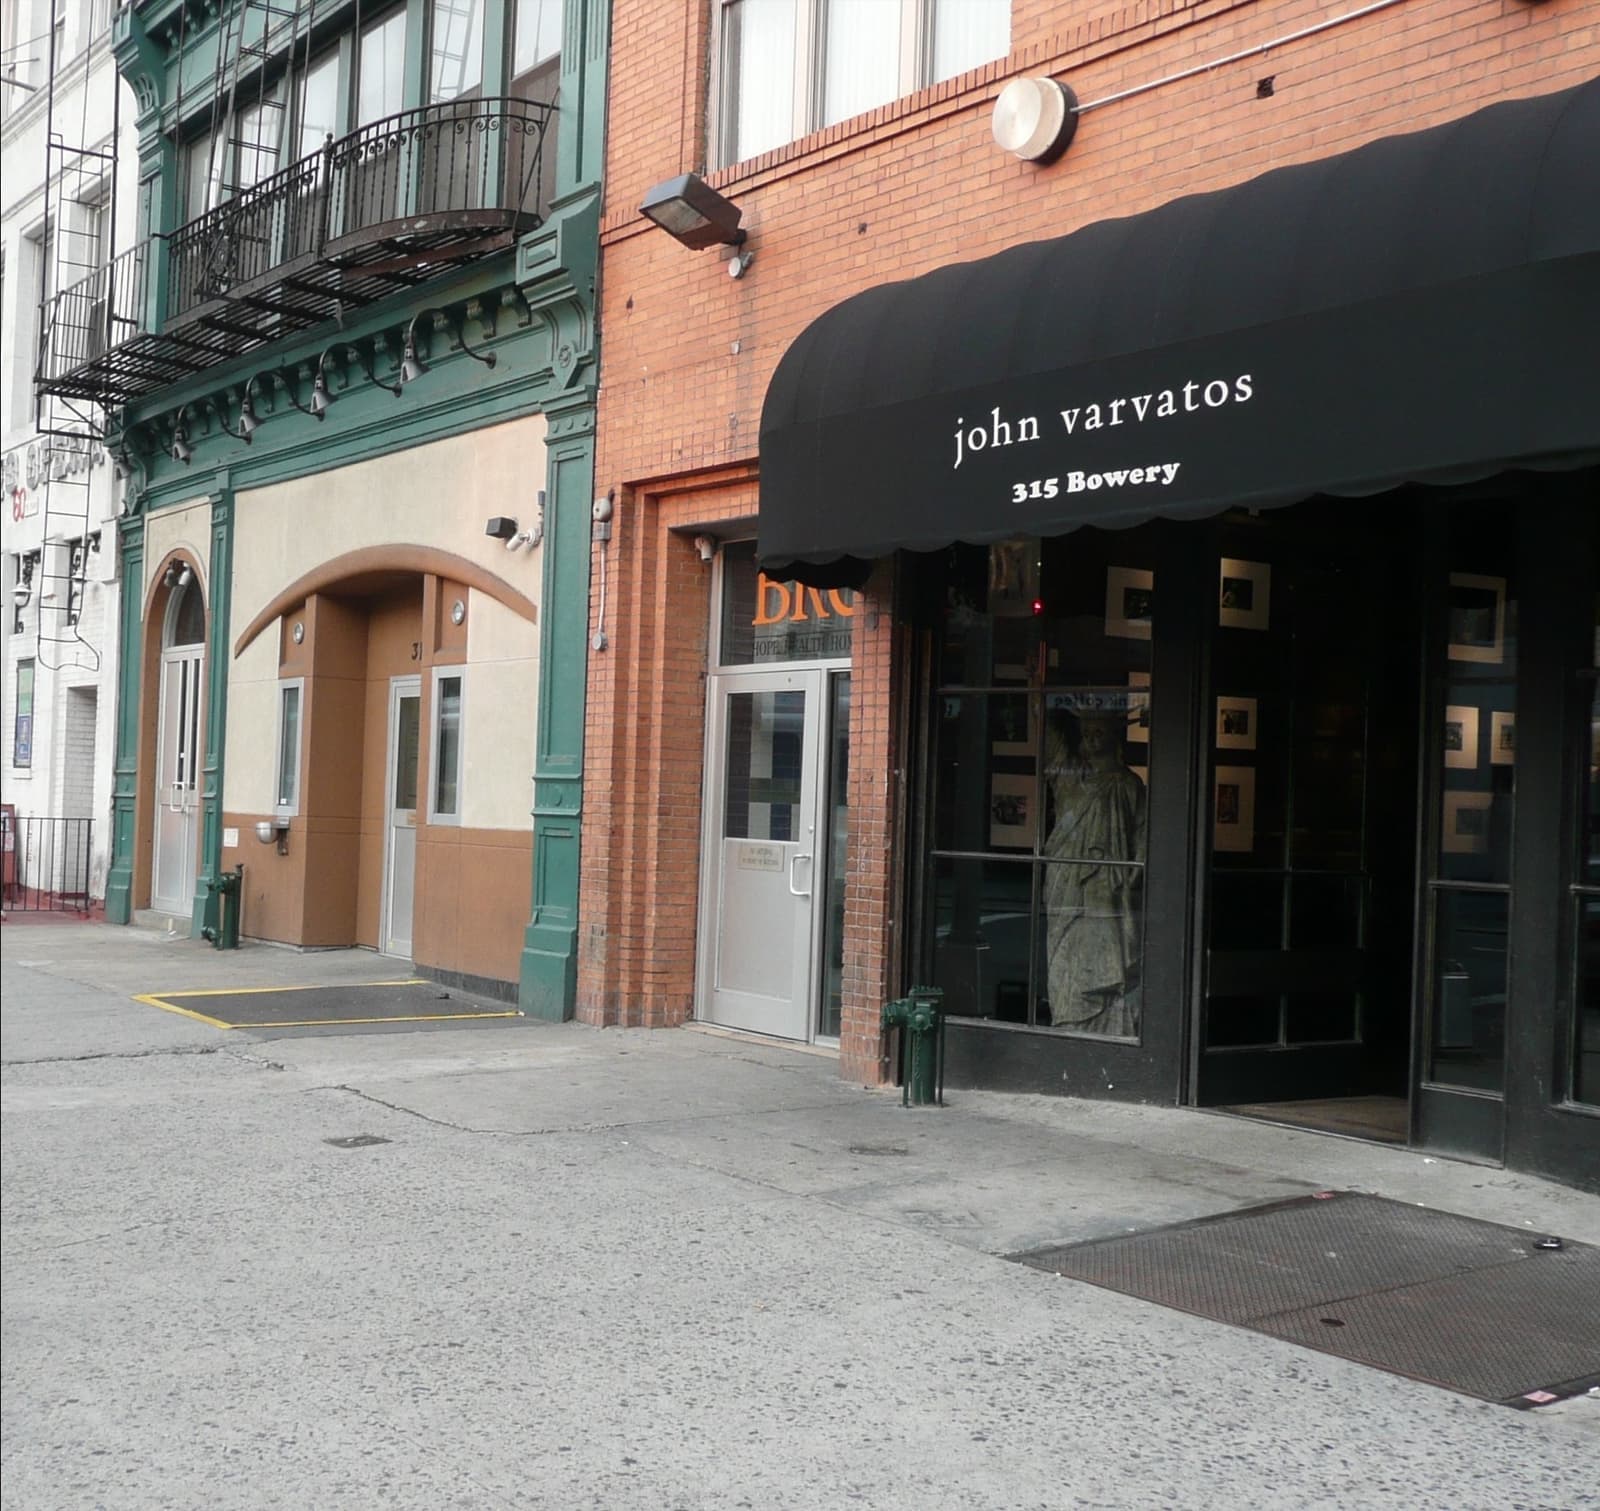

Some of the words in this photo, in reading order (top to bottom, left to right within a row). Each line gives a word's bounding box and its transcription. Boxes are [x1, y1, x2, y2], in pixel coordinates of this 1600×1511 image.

[954, 407, 1040, 469] john
[1061, 375, 1252, 434] varvatos
[1013, 478, 1058, 502] 315
[1067, 463, 1180, 492] Bowery
